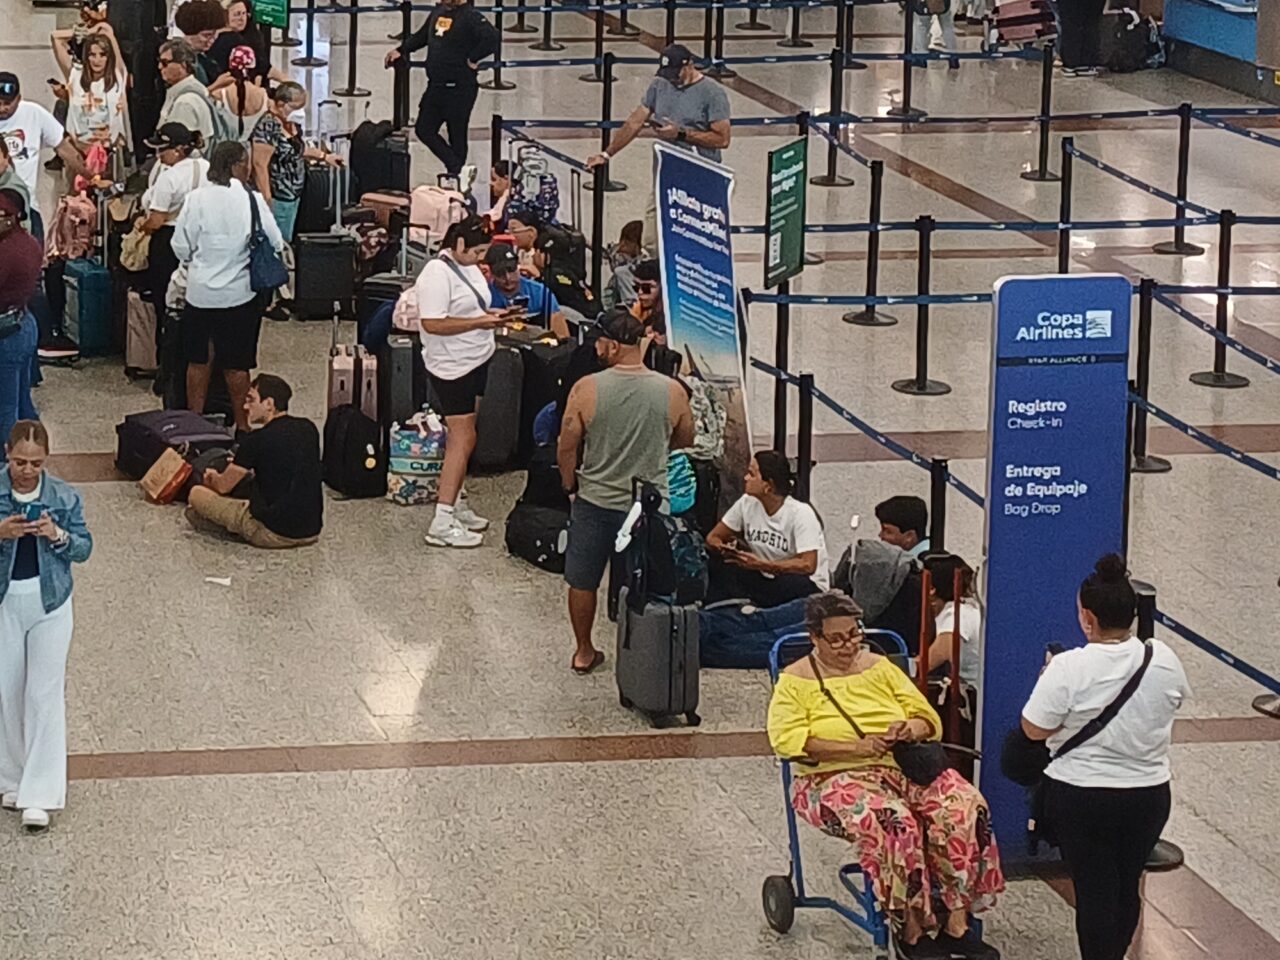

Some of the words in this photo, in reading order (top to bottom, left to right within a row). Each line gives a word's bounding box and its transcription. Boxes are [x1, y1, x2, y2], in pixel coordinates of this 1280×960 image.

[1037, 311, 1084, 330] Copa
[1015, 326, 1084, 341] Airlines
[1007, 399, 1067, 416] Registro
[1005, 464, 1061, 479] Entrega
[1004, 483, 1023, 497] de
[1026, 480, 1088, 498] Equipaje
[1004, 503, 1029, 517] Bag
[1031, 502, 1062, 515] Drop
